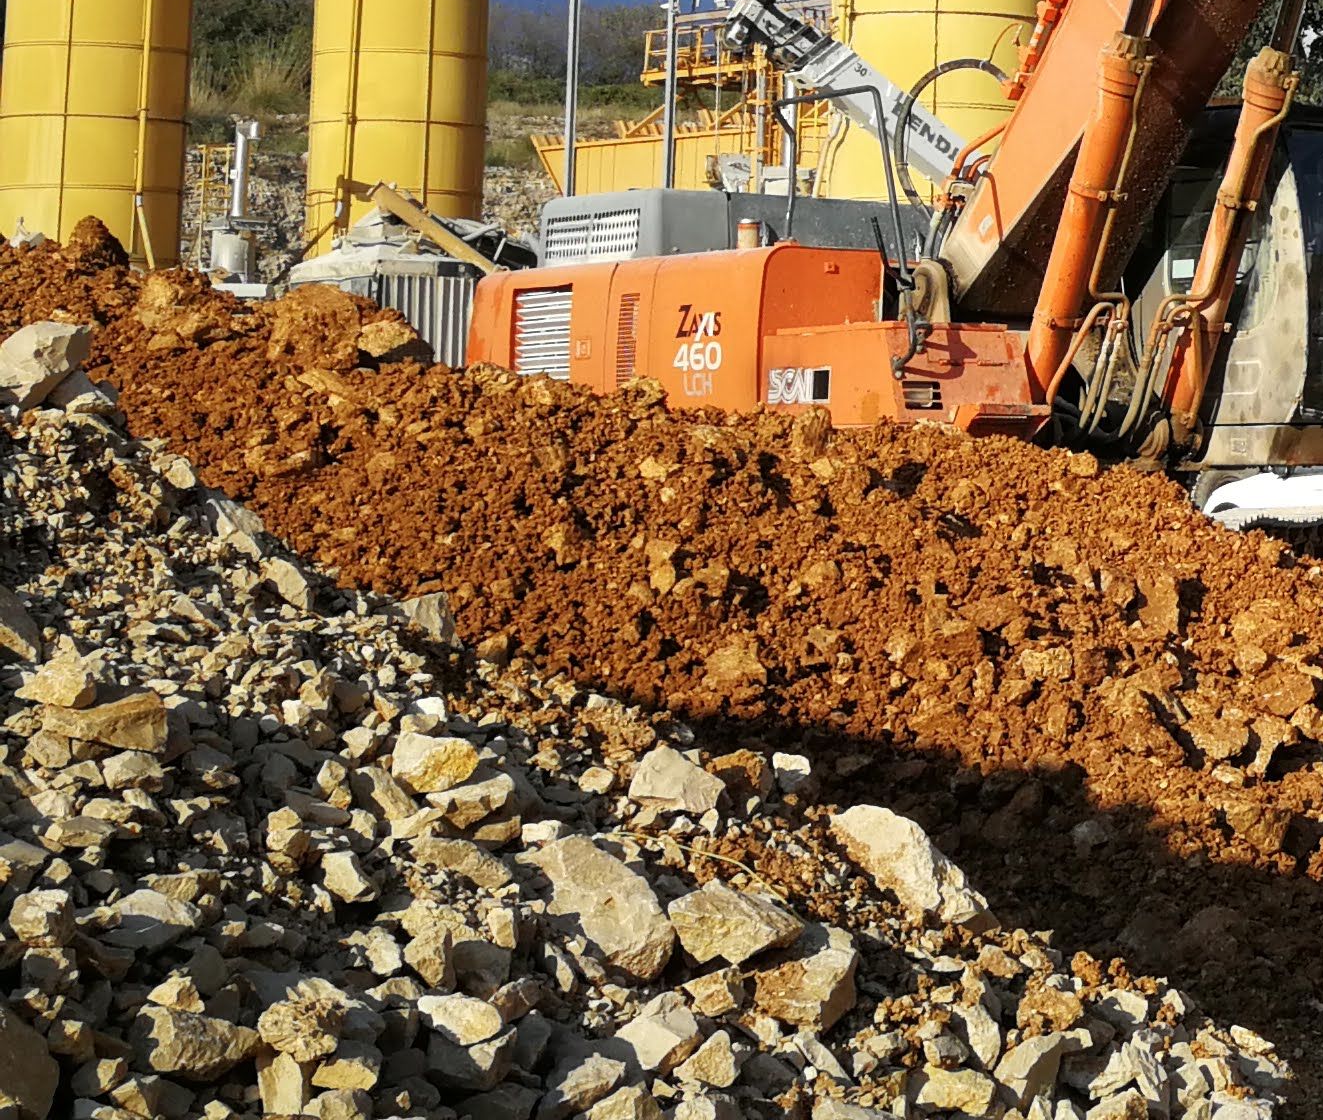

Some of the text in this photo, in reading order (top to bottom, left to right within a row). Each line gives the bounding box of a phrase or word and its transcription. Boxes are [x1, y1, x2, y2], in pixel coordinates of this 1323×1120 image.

[853, 62, 868, 77] 30
[673, 341, 722, 372] 460
[682, 373, 713, 397] LCH
